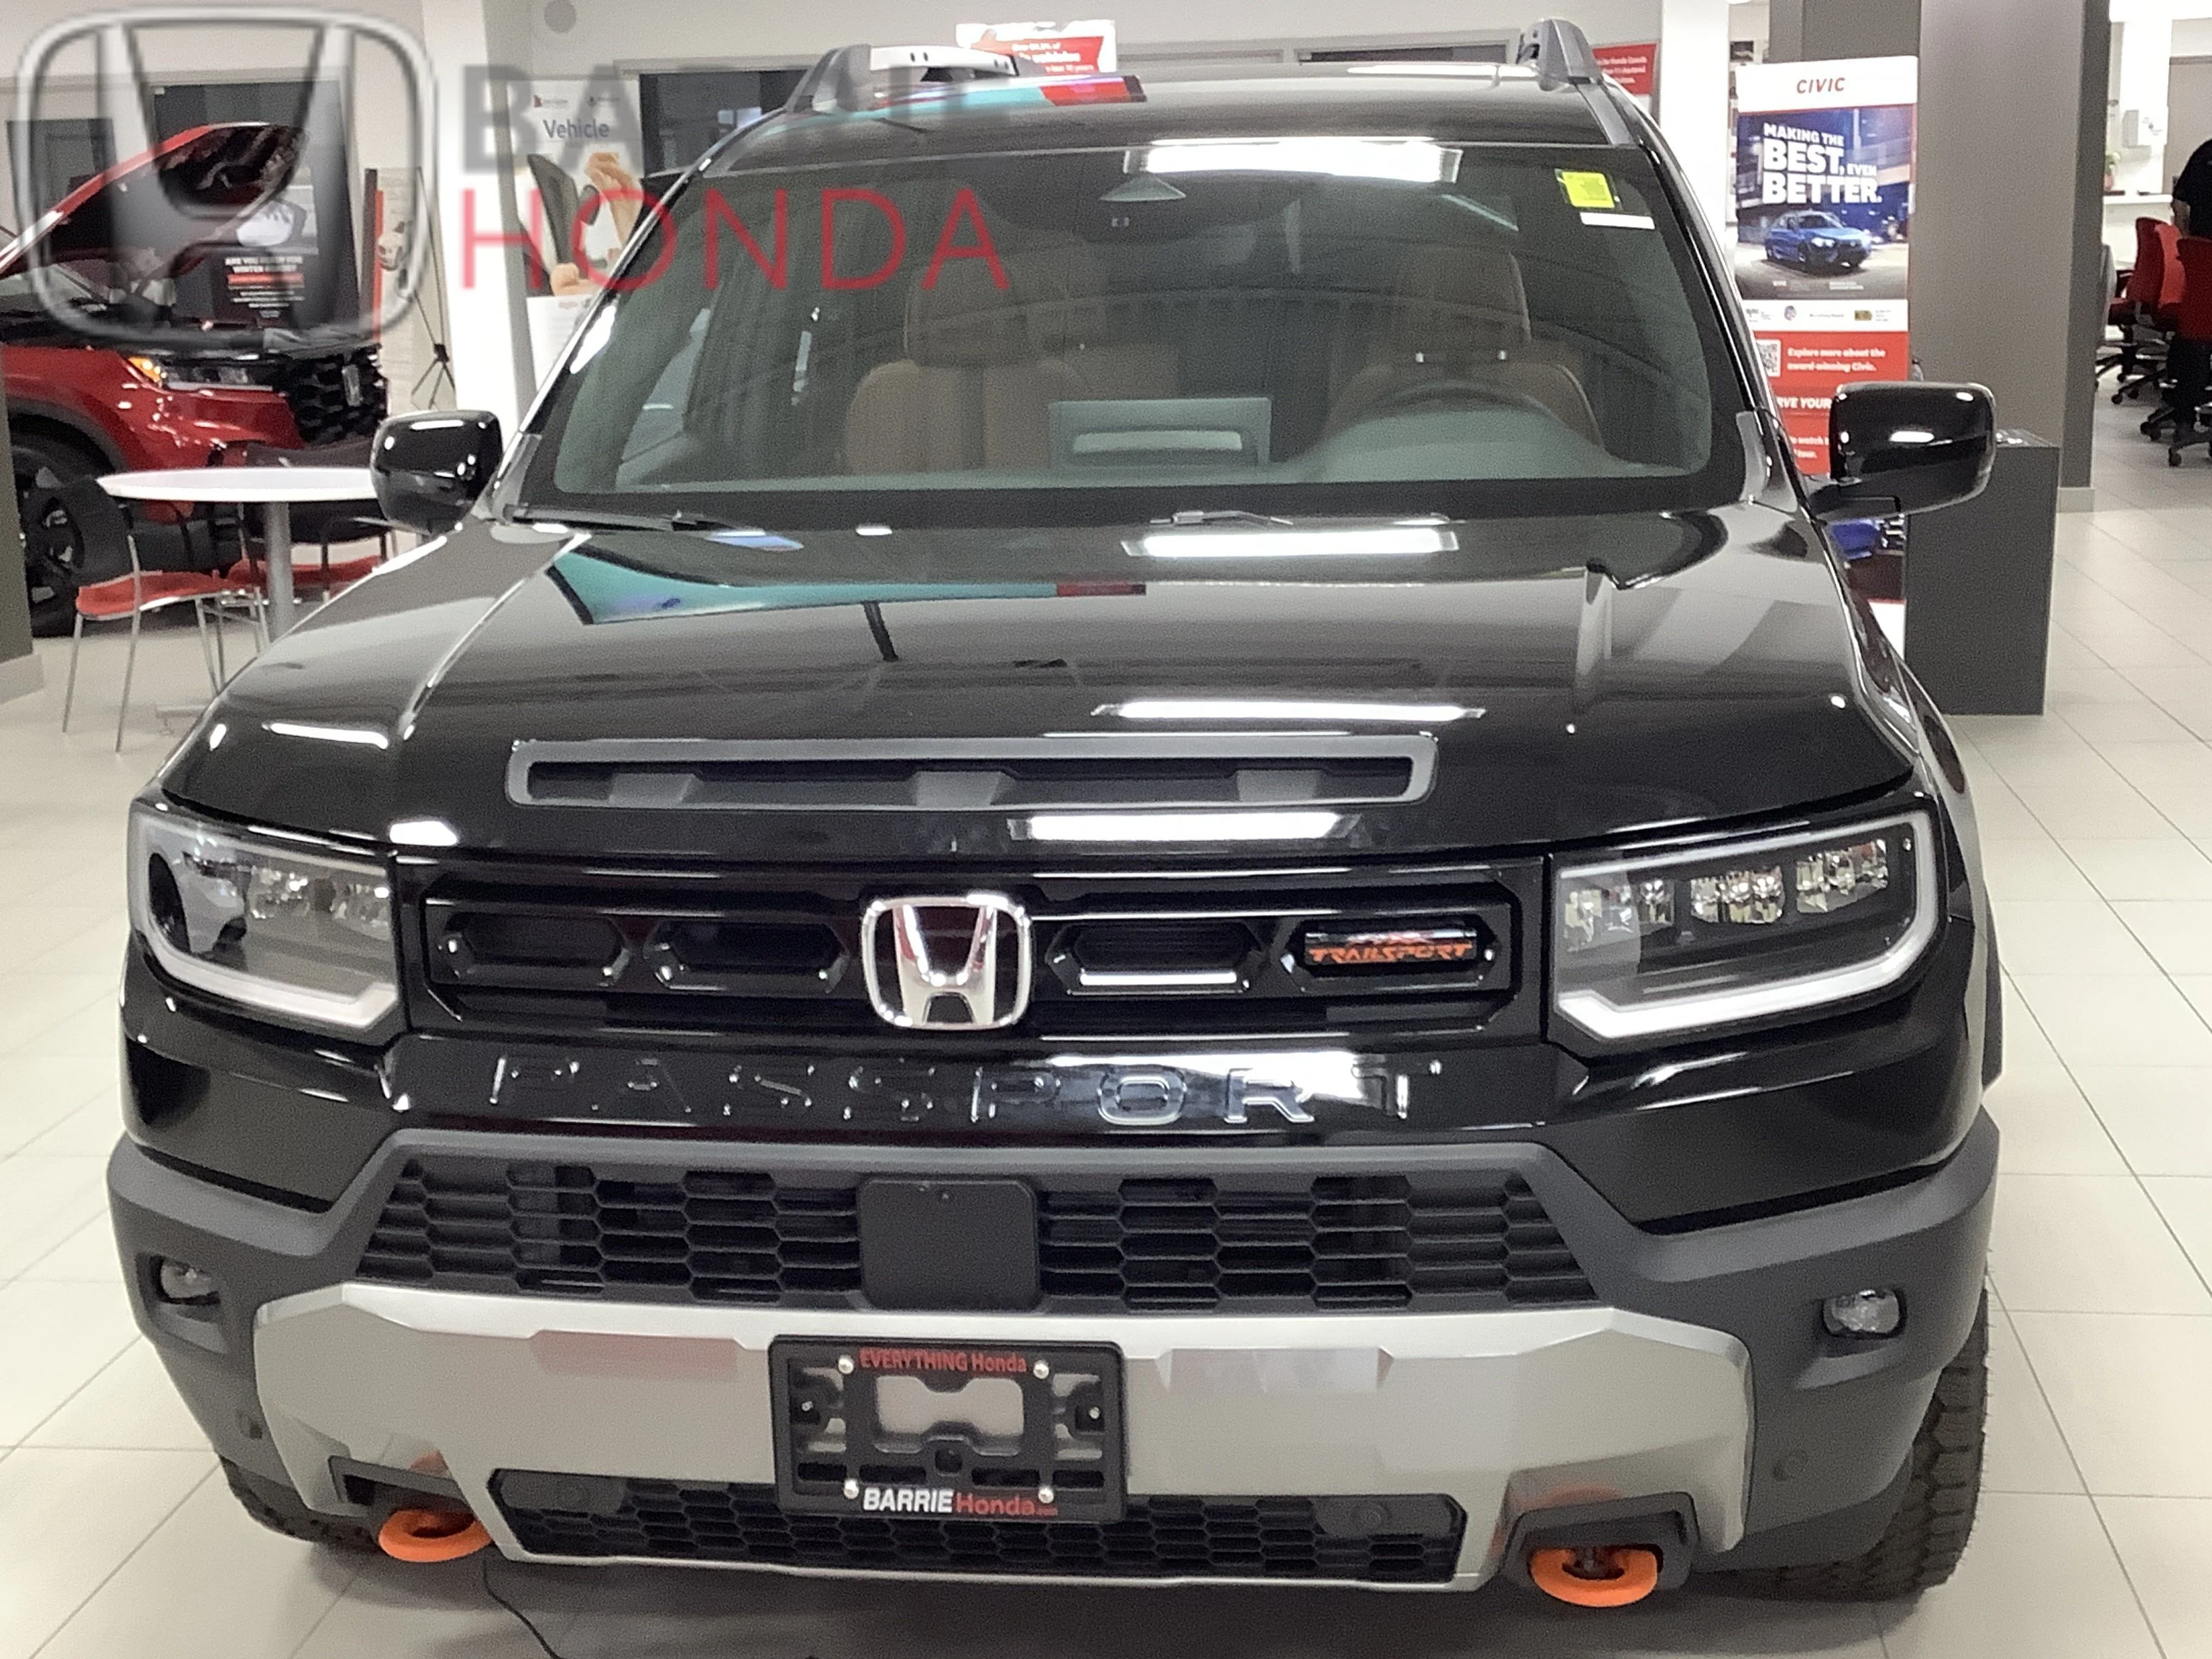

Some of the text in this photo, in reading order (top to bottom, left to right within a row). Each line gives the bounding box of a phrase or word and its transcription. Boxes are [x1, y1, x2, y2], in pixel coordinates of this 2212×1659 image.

[1797, 77, 1845, 94] CIVIC
[543, 119, 610, 139] Vehicle
[1763, 123, 1844, 146] MAKING THE
[1763, 138, 1877, 176] BEST, EVEN
[1762, 172, 1883, 203] BETTER.
[859, 1347, 1027, 1372] EVERYTHING Honda
